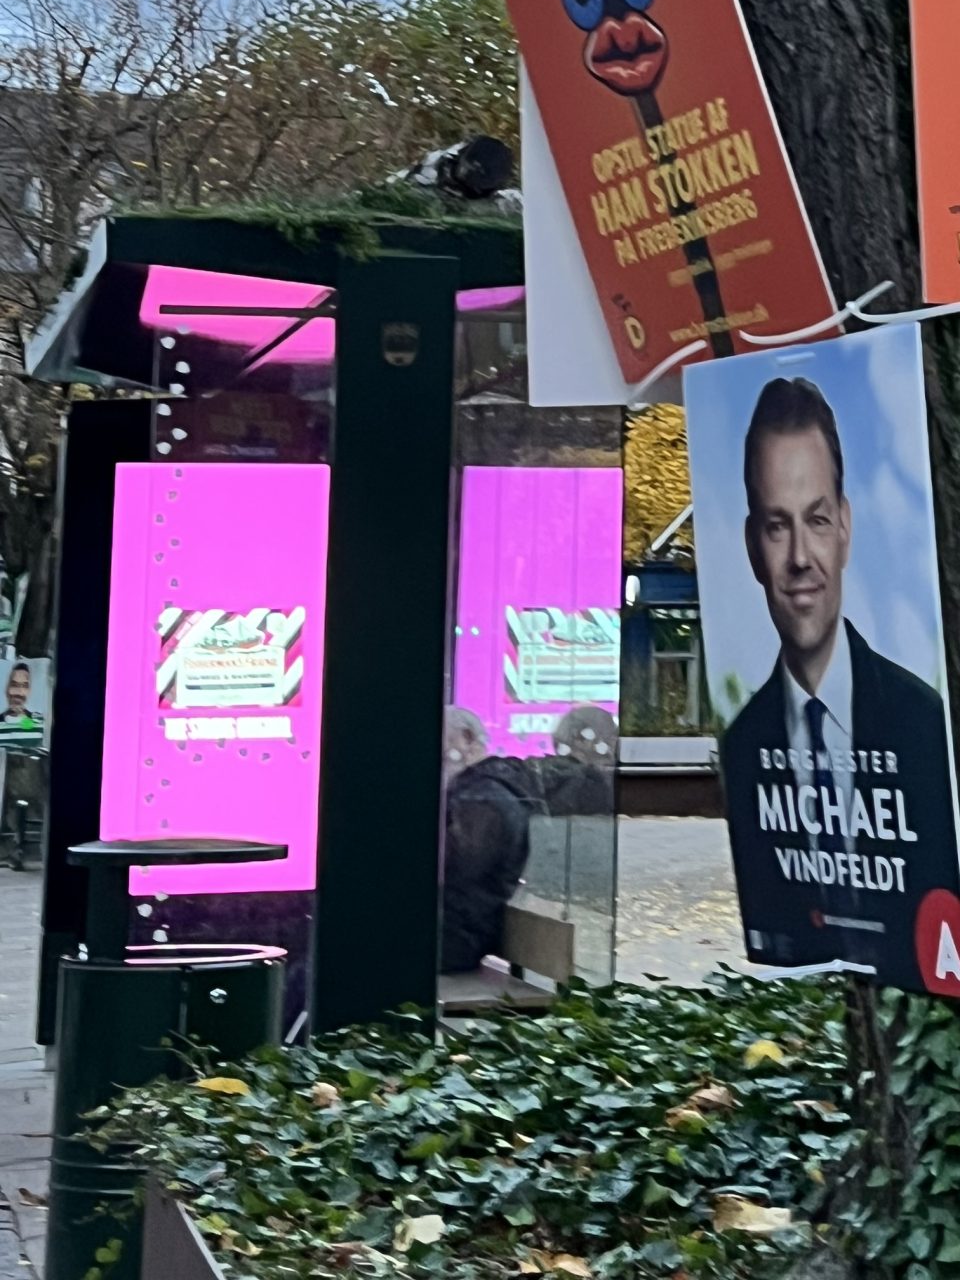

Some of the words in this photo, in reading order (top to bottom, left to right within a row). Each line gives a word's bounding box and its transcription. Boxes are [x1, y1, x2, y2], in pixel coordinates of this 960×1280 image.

[706, 98, 729, 135] AF
[591, 177, 649, 236] HAM
[647, 129, 760, 213] STOKKEN
[757, 783, 918, 842] MICHAEL
[775, 846, 906, 893] VINDFELDT
